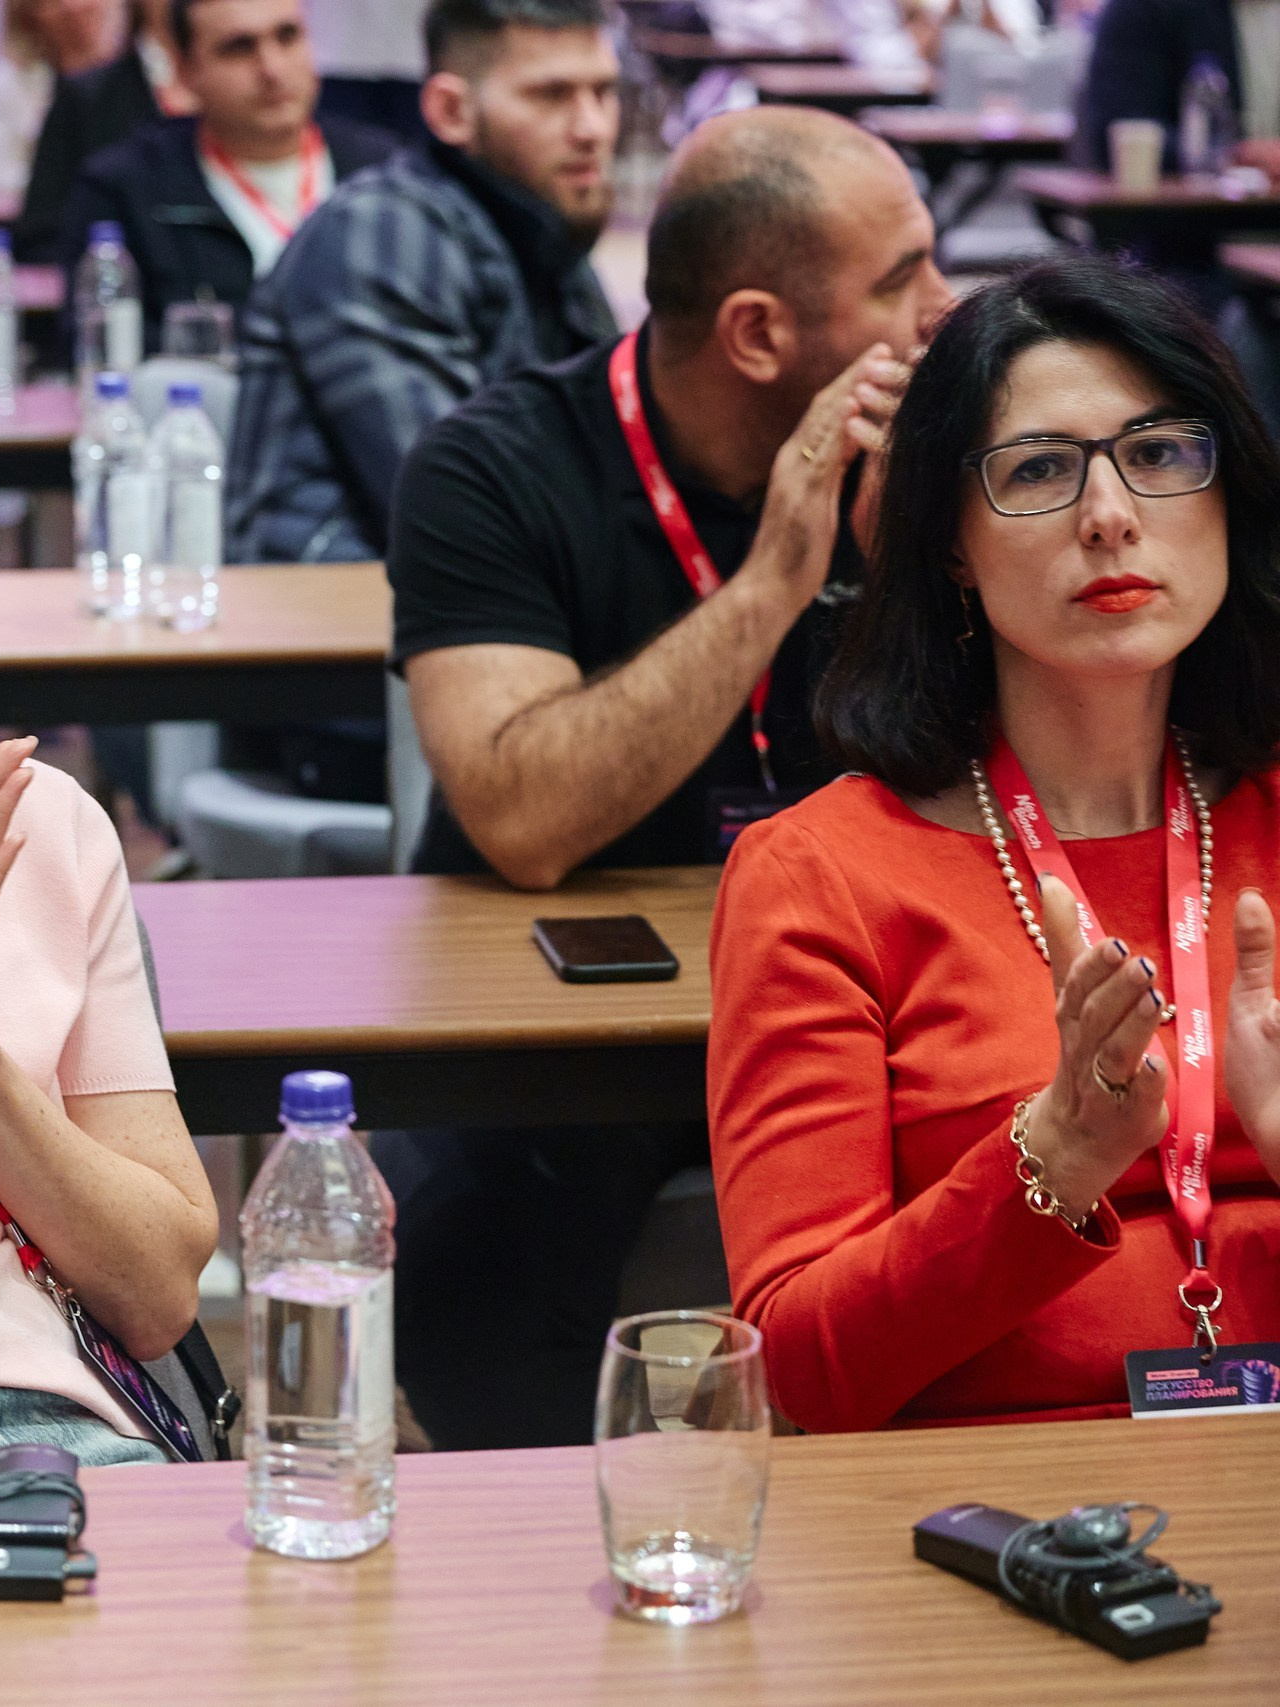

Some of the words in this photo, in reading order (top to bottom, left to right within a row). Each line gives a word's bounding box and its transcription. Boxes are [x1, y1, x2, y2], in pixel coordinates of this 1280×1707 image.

[1013, 794, 1039, 821] Neo
[1013, 806, 1042, 849] Biotech
[1174, 921, 1194, 953] Neo
[1182, 896, 1199, 943] Biotech
[1184, 1034, 1200, 1069] Neo
[1190, 1008, 1207, 1056] Biotech
[1189, 1132, 1207, 1189] Biotech
[1180, 1164, 1199, 1201] Neo
